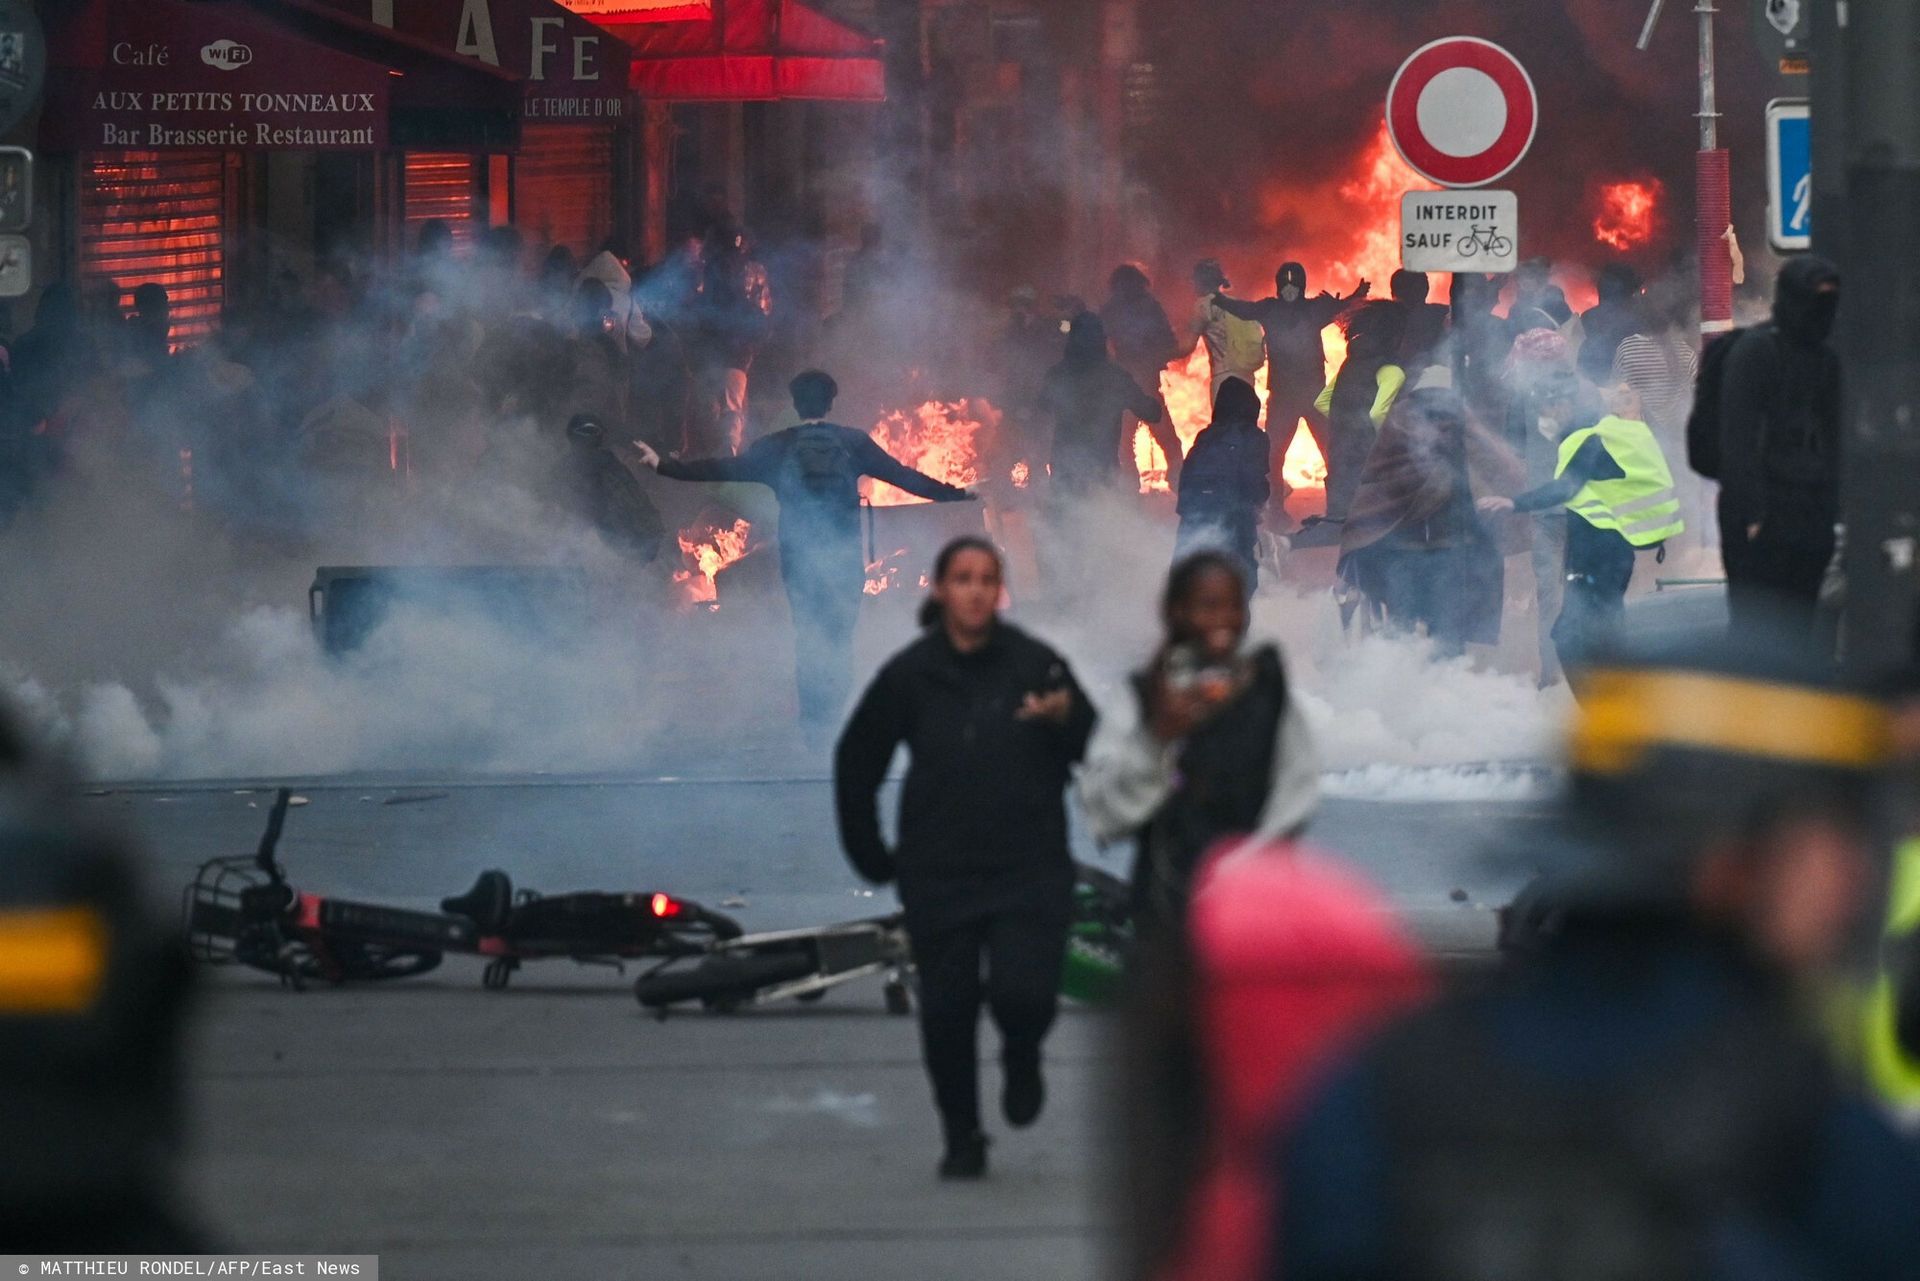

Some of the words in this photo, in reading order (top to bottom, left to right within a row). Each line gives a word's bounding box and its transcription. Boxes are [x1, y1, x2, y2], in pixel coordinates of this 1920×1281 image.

[112, 42, 170, 66] Café
[92, 92, 143, 111] AUX
[151, 92, 233, 112] PETITS
[240, 93, 375, 113] TONNEAUX
[524, 98, 540, 117] LE
[543, 98, 590, 117] TEMPLE
[103, 123, 141, 145] Bar
[148, 122, 248, 145] Brasserie
[255, 123, 375, 146] Restaurant
[1416, 205, 1497, 220] INTERDIT
[1405, 233, 1452, 248] SAUF
